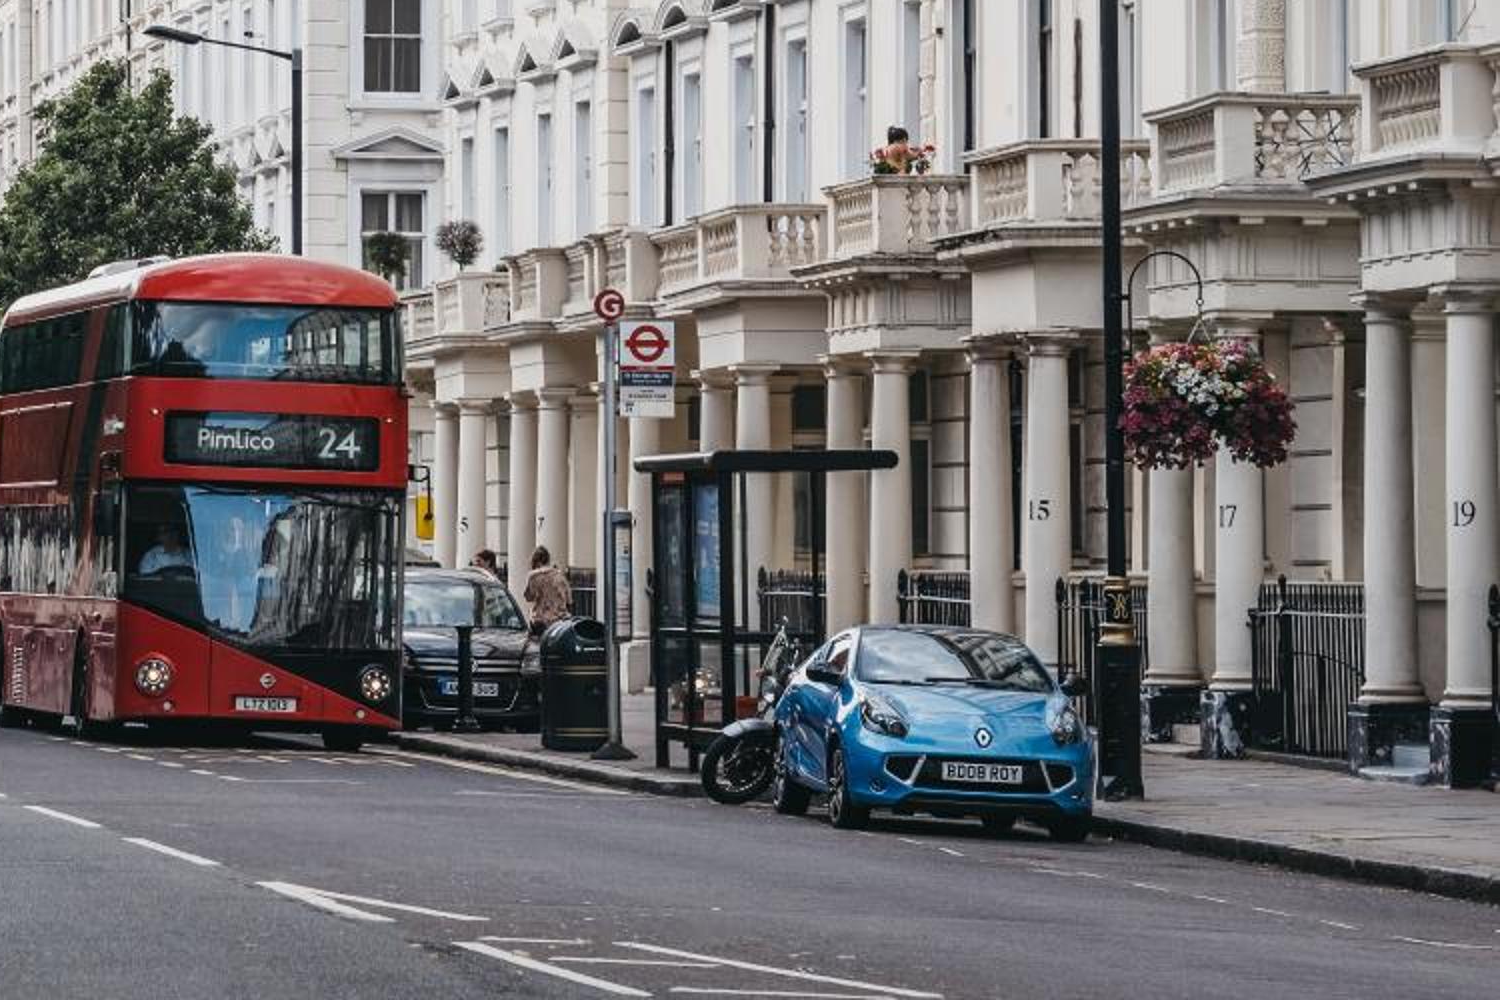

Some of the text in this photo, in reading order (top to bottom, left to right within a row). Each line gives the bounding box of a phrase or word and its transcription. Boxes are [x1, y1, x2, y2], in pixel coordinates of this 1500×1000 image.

[600, 294, 621, 316] G
[197, 428, 361, 459] Pimlico 24
[1029, 500, 1050, 520] 15
[1219, 504, 1237, 528] 17
[1453, 500, 1476, 527] 19
